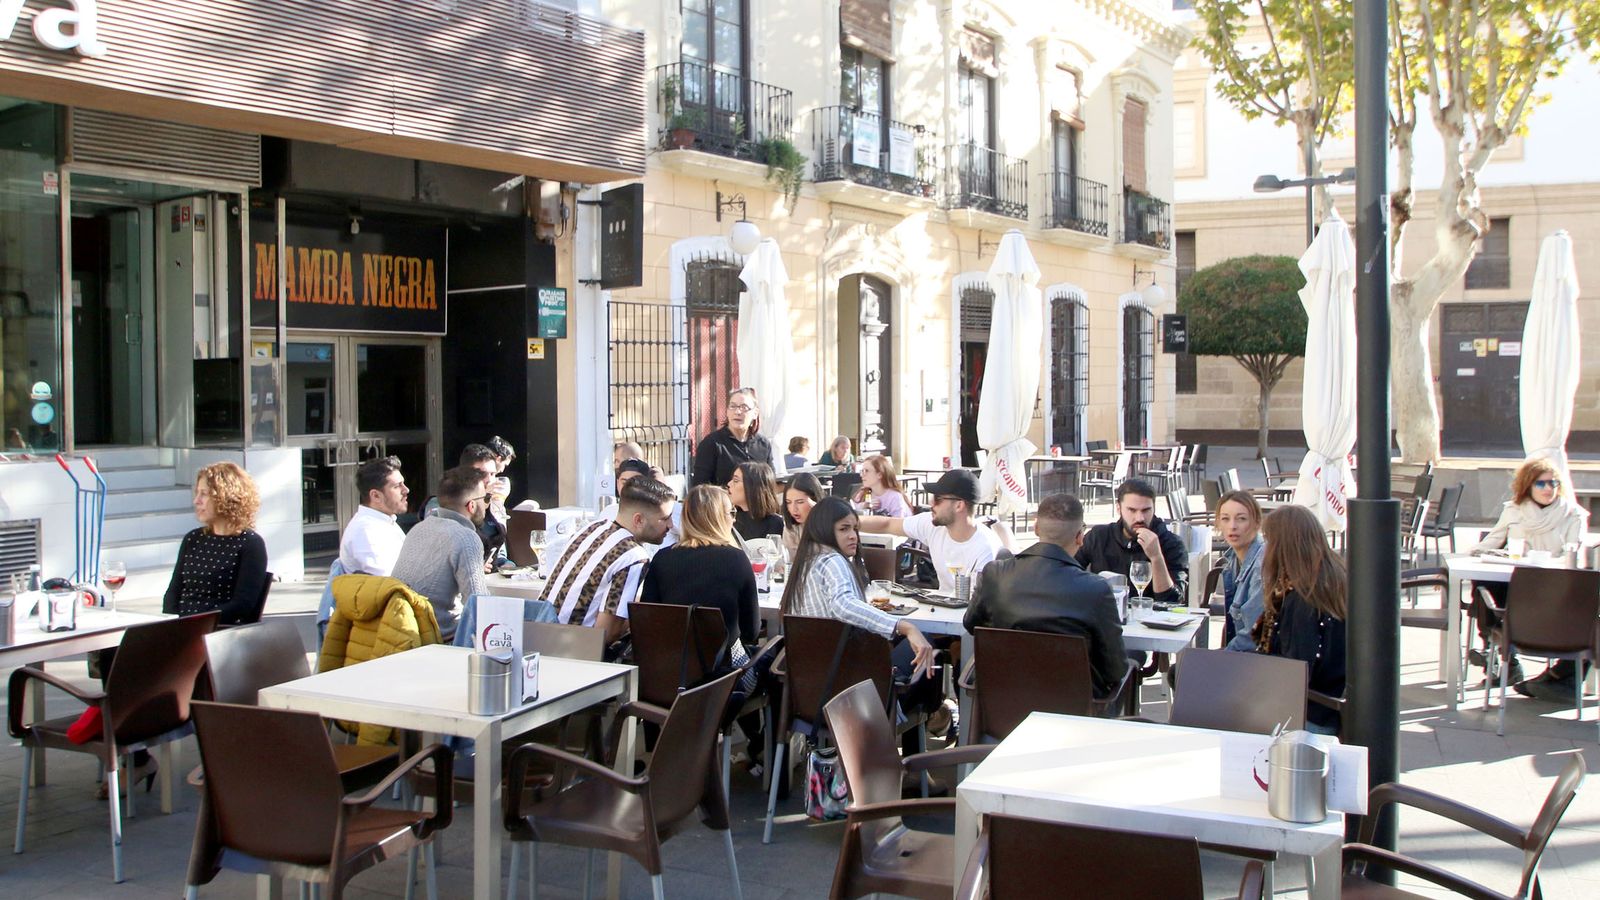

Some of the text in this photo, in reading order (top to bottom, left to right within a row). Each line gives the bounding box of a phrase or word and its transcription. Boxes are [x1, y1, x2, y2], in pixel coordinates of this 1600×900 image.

[255, 242, 437, 310] MAMBA NEGRA
[503, 632, 512, 641] la
